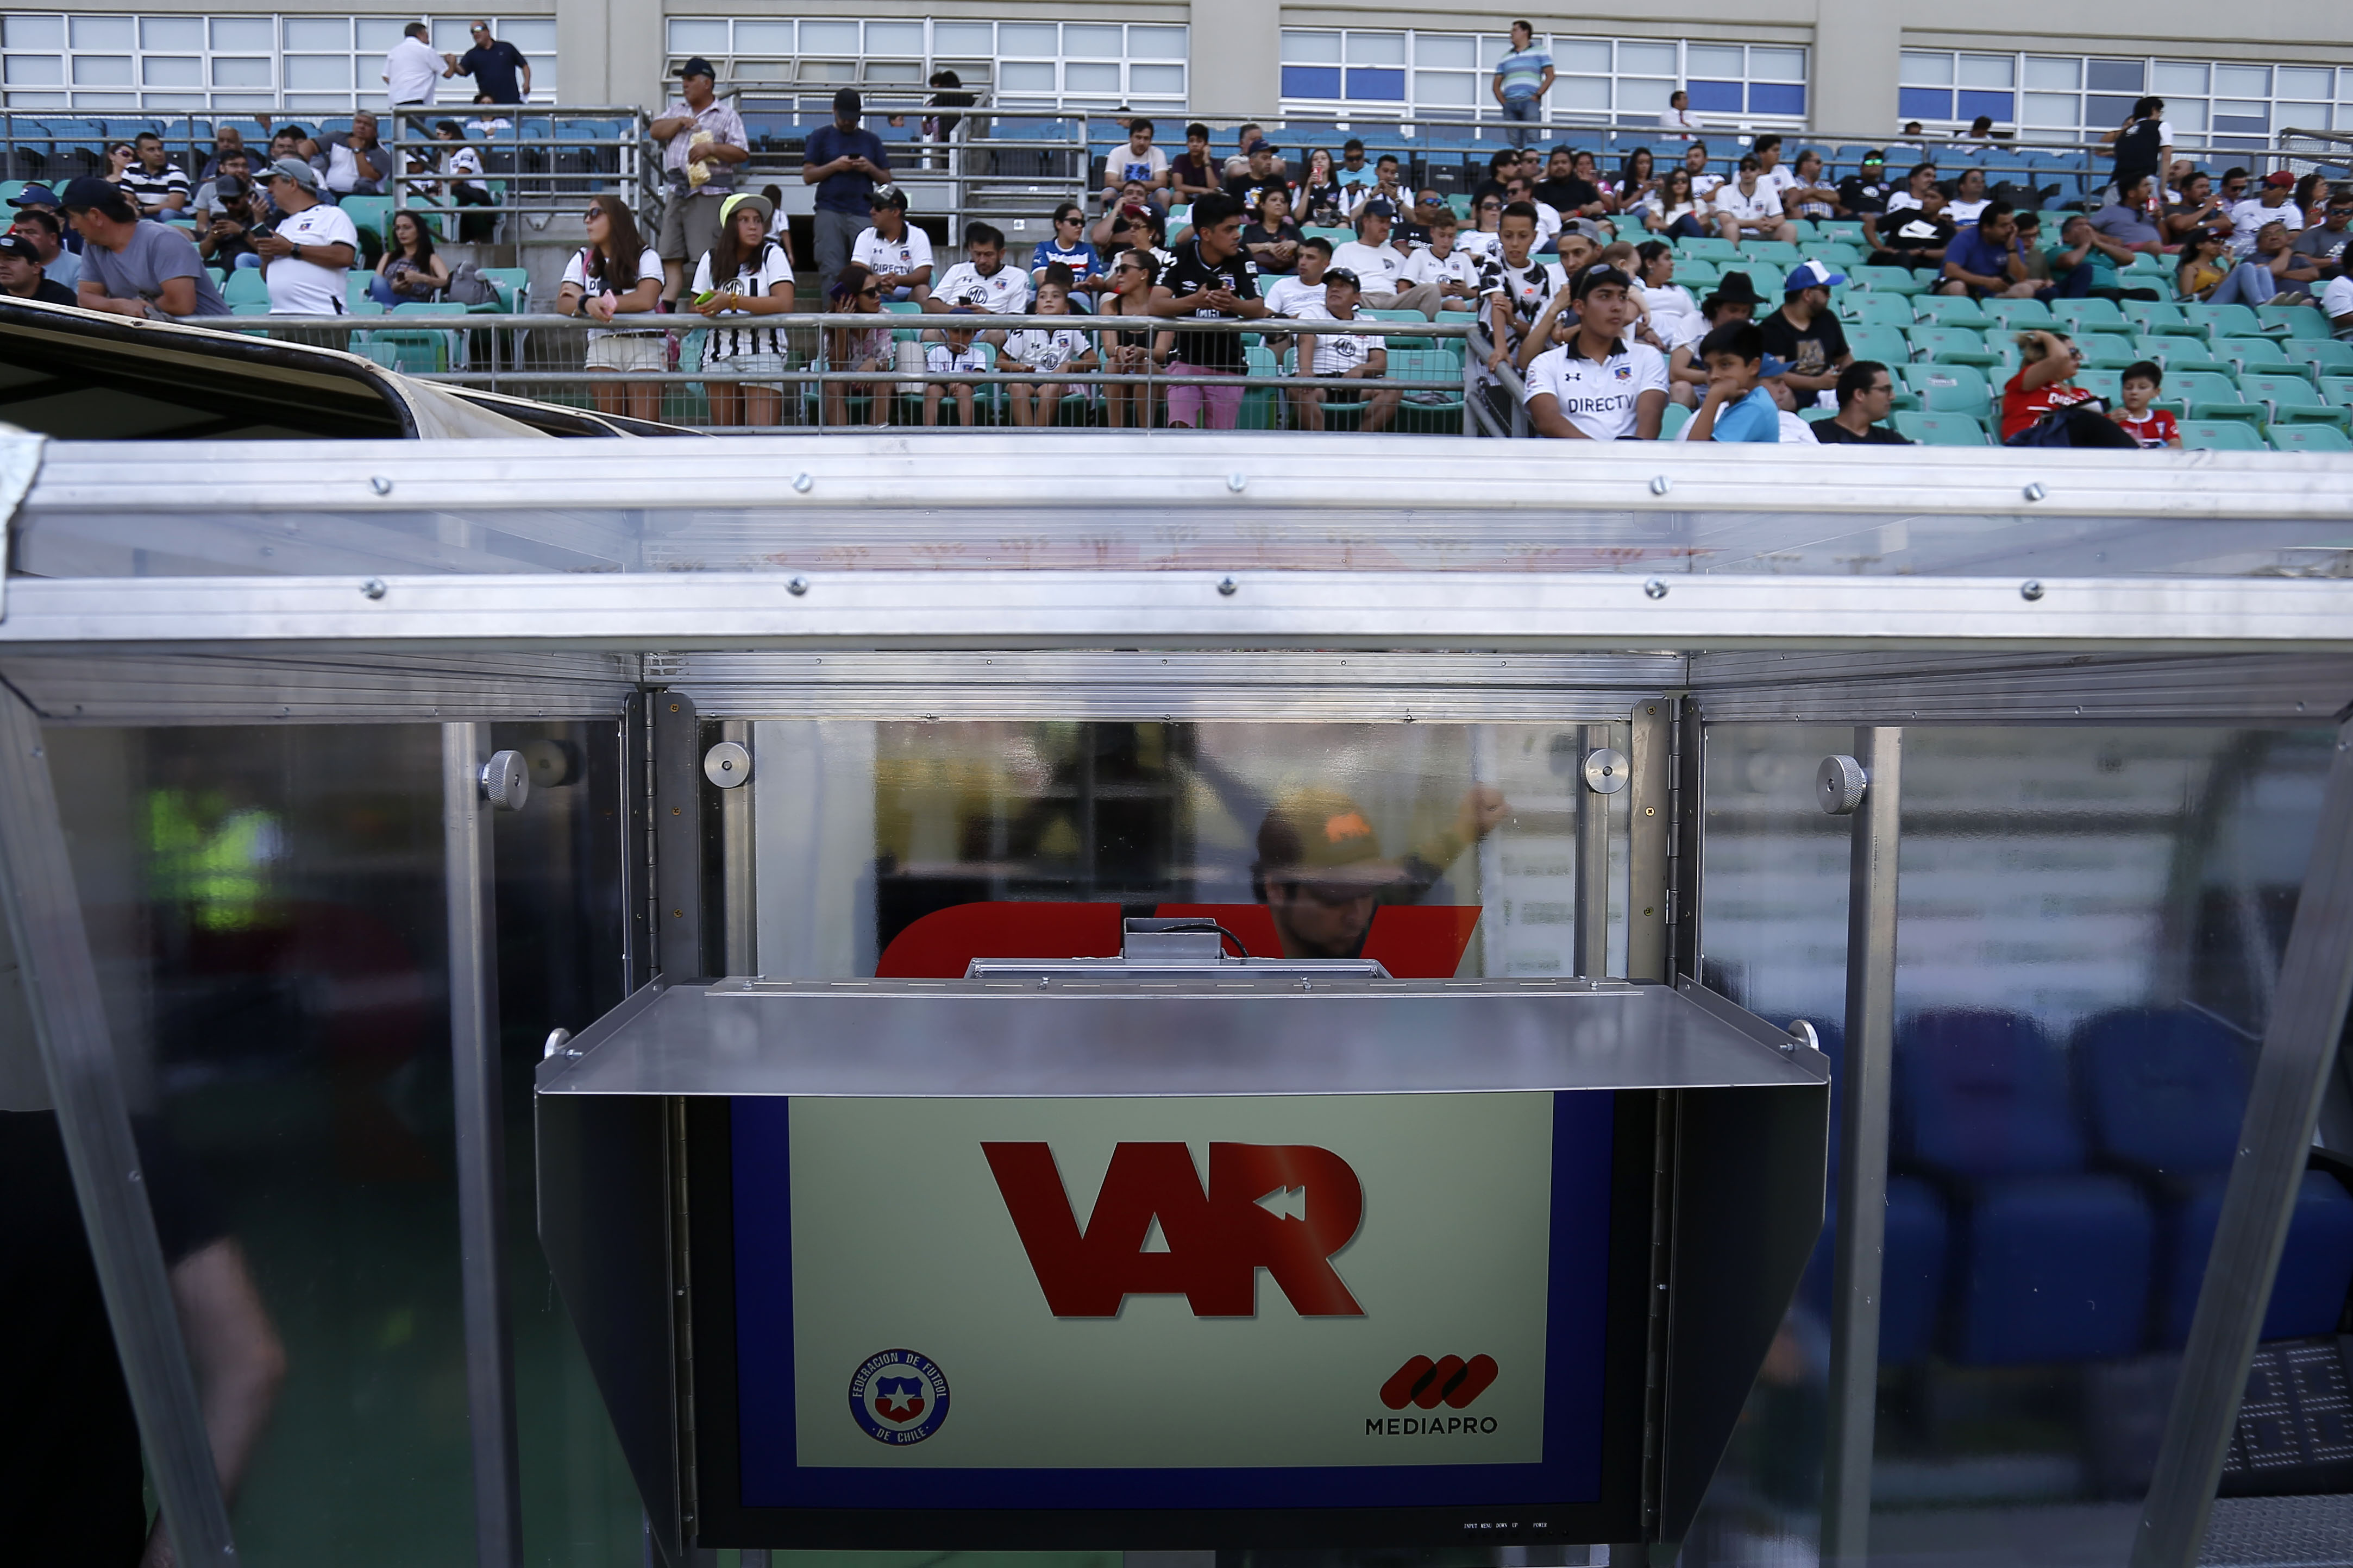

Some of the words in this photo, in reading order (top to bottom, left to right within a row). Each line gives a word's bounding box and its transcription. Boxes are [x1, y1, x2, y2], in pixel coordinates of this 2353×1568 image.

[1408, 240, 1433, 249] DIREC
[1568, 394, 1634, 413] DIRECTV
[980, 1141, 1366, 1318] VAR
[852, 1352, 899, 1397] FEDERACION
[906, 1353, 920, 1366] DE
[923, 1363, 946, 1399] FUTBOL
[876, 1428, 891, 1441] DE
[898, 1427, 926, 1443] CHILE
[1365, 1416, 1498, 1435] MEDIAPRO
